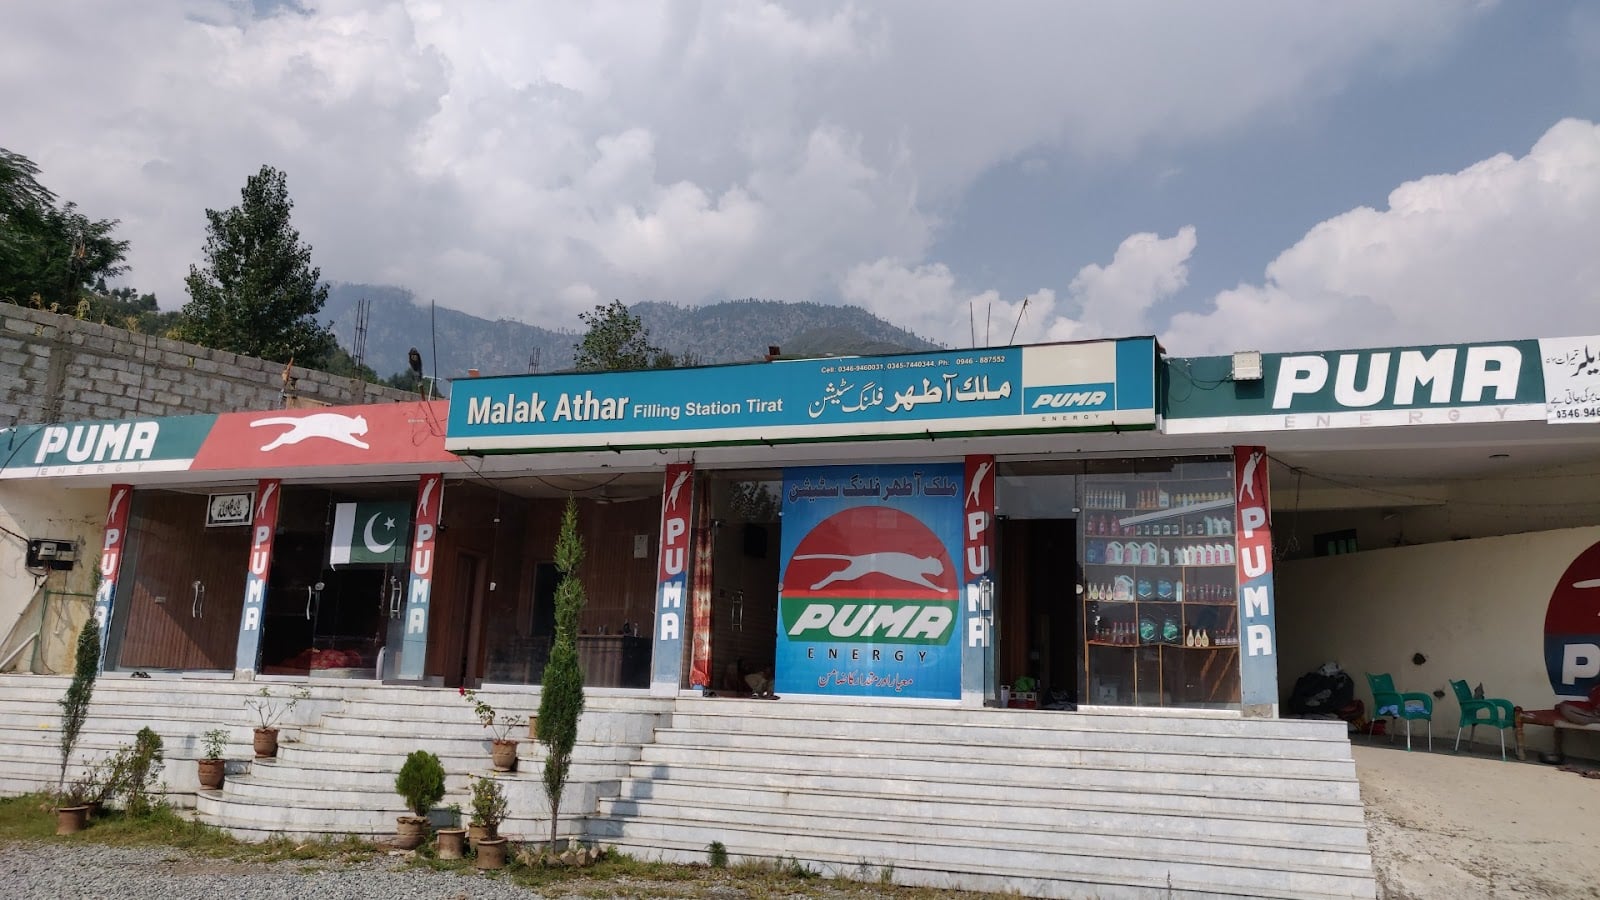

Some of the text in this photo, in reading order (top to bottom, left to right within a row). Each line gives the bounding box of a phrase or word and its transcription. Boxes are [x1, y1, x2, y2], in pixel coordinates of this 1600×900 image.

[821, 366, 837, 374] Cell:
[1272, 345, 1523, 410] PUMA
[467, 390, 783, 426] Malak Athar Filling Station Tirat
[1031, 391, 1107, 409] PUMA
[1041, 413, 1099, 422] ENERGY
[1284, 407, 1509, 429] ENERGY
[34, 421, 160, 464] PUMA
[40, 462, 144, 476] ENERGY
[94, 528, 120, 628] PUMA
[244, 526, 270, 631] PUMA
[407, 524, 433, 634] PUMA
[660, 518, 685, 641] PUMA
[967, 511, 990, 648] PUMA
[1241, 507, 1272, 657] PUMA
[788, 603, 953, 639] PUMA
[808, 648, 927, 662] ENERGY
